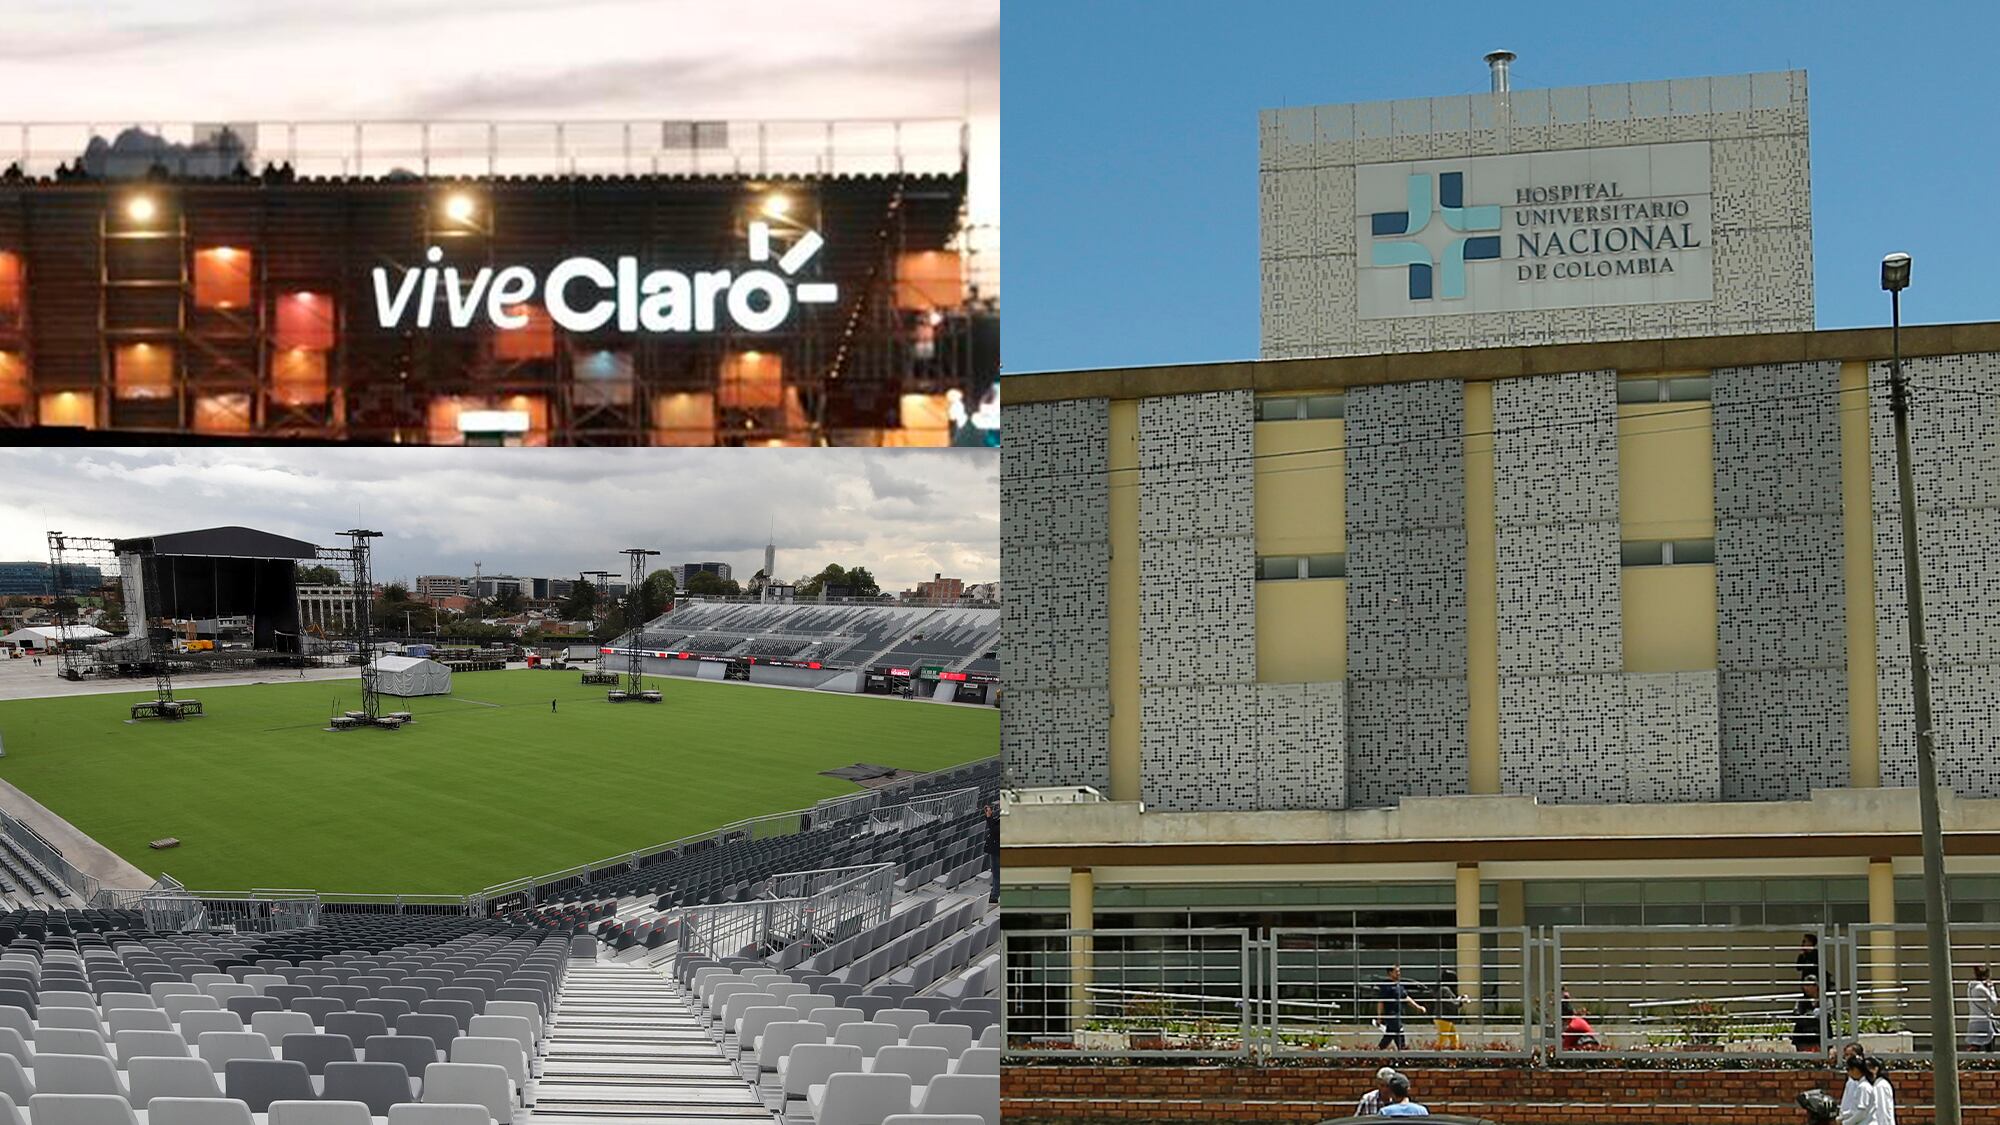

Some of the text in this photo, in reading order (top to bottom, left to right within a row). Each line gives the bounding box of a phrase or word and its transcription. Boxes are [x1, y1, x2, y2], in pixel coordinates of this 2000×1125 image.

[1517, 182, 1623, 203] HOSPITAL
[1517, 200, 1689, 226] UNIVERSITARIO
[1517, 223, 1701, 258] NACIONAL
[1518, 258, 1674, 281] DE COLOMBIA
[544, 256, 790, 332] Claro
